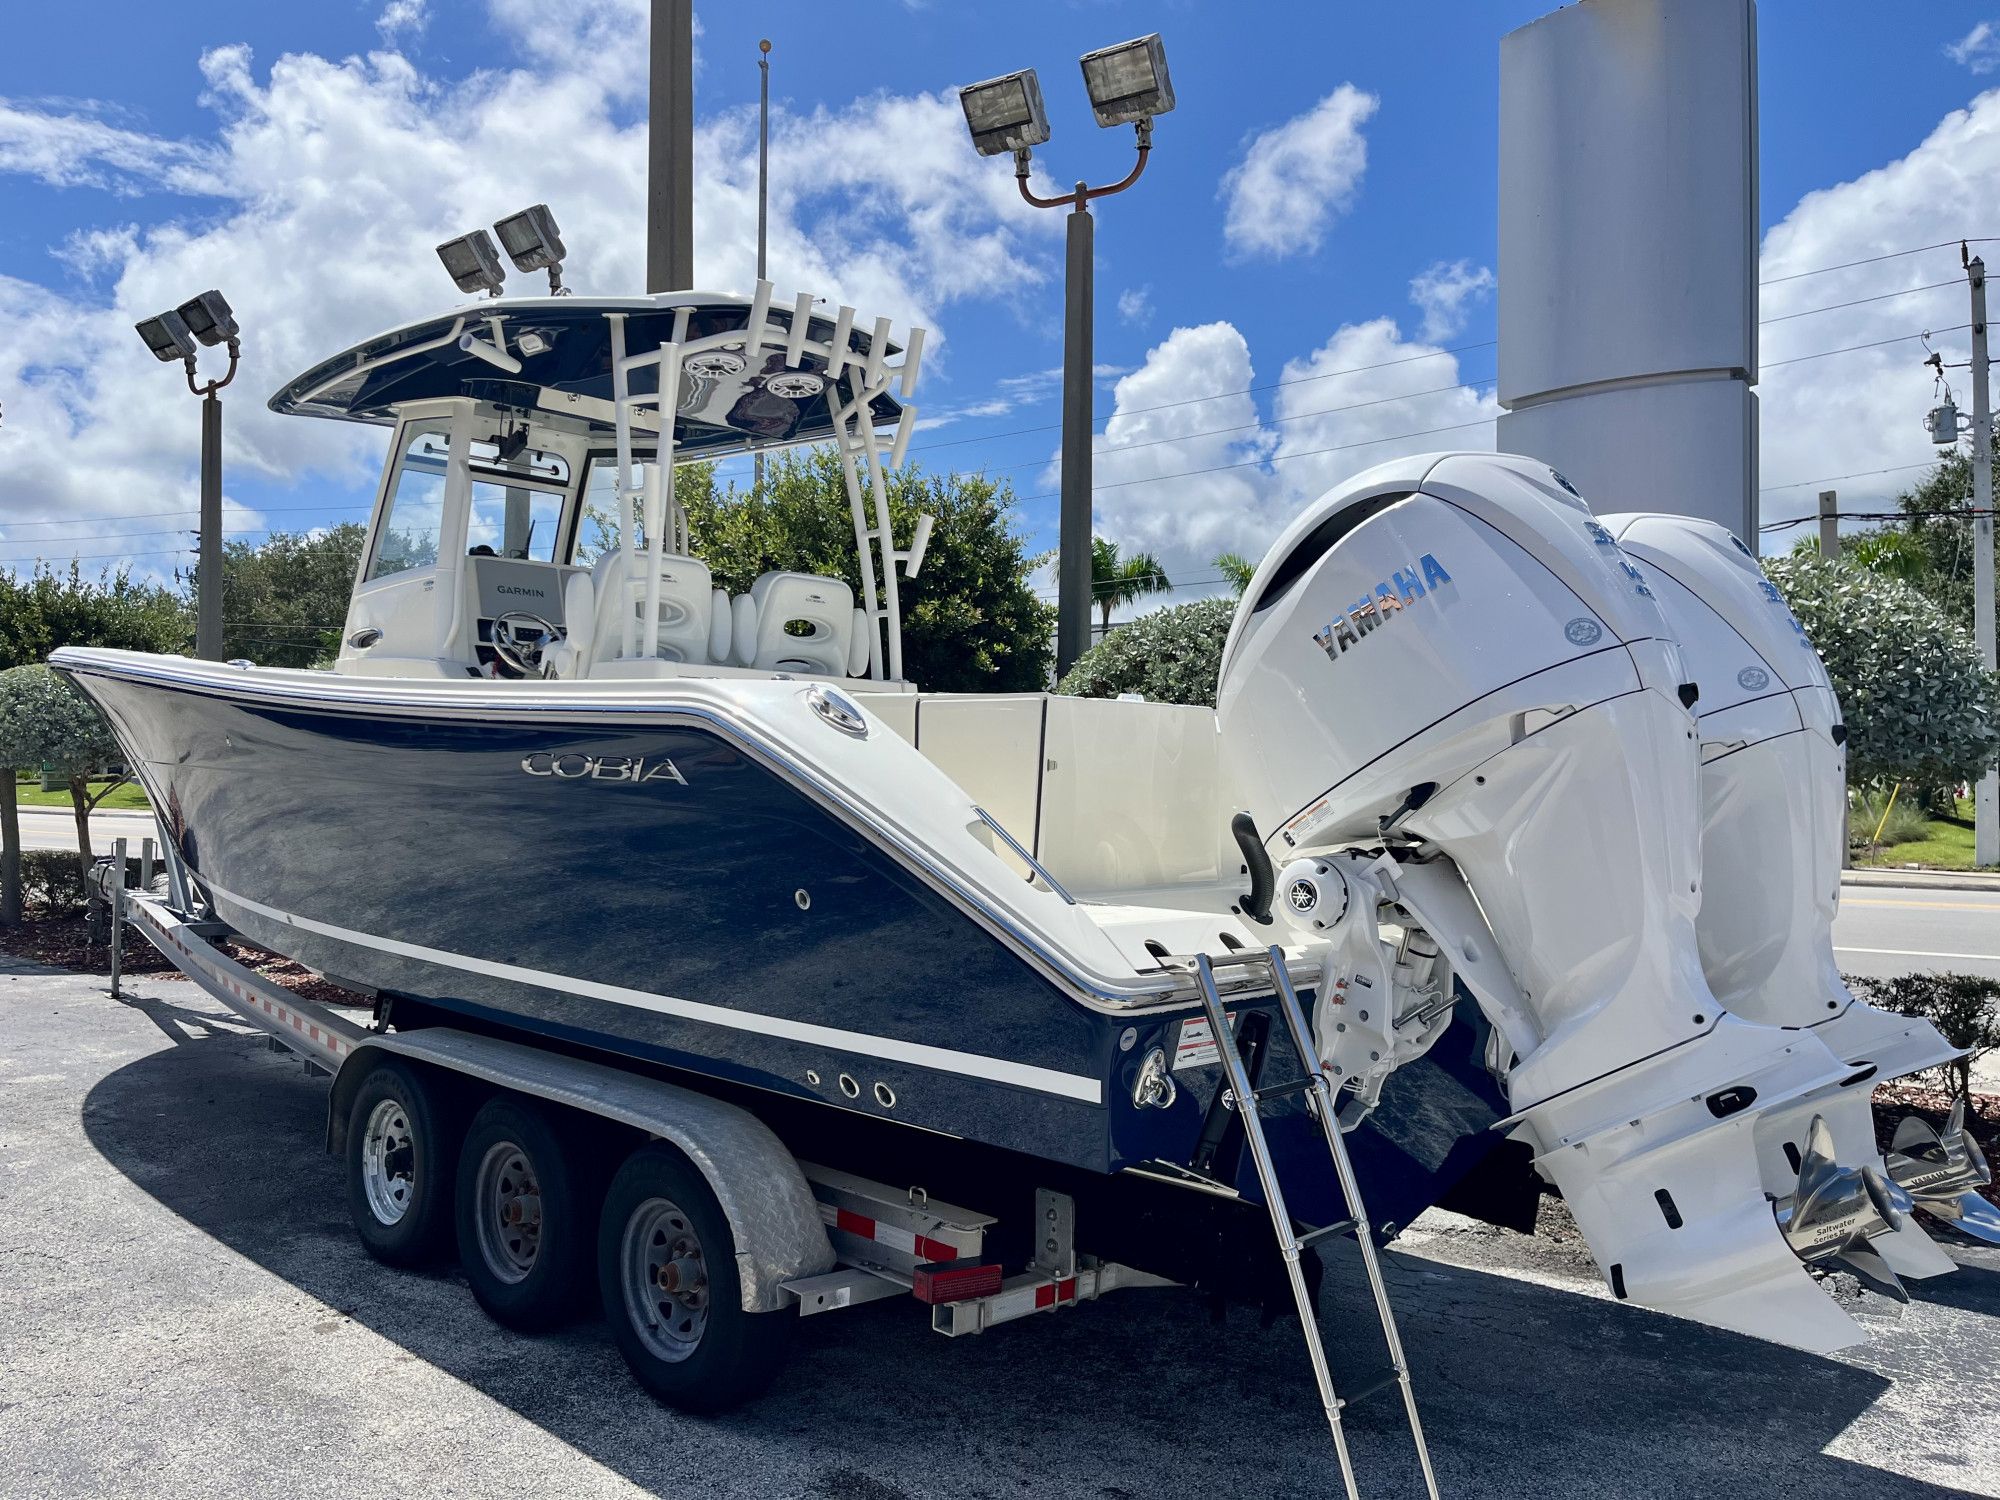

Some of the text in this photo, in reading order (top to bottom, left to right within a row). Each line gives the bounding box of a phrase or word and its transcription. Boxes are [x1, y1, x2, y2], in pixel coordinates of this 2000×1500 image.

[497, 585, 545, 598] GARMIN
[1312, 553, 1452, 661] YAMAHA
[521, 752, 689, 786] COBIA
[1911, 1170, 1949, 1187] YAMAHA
[1816, 1218, 1856, 1236] Saltwater
[1813, 1232, 1839, 1244] Series
